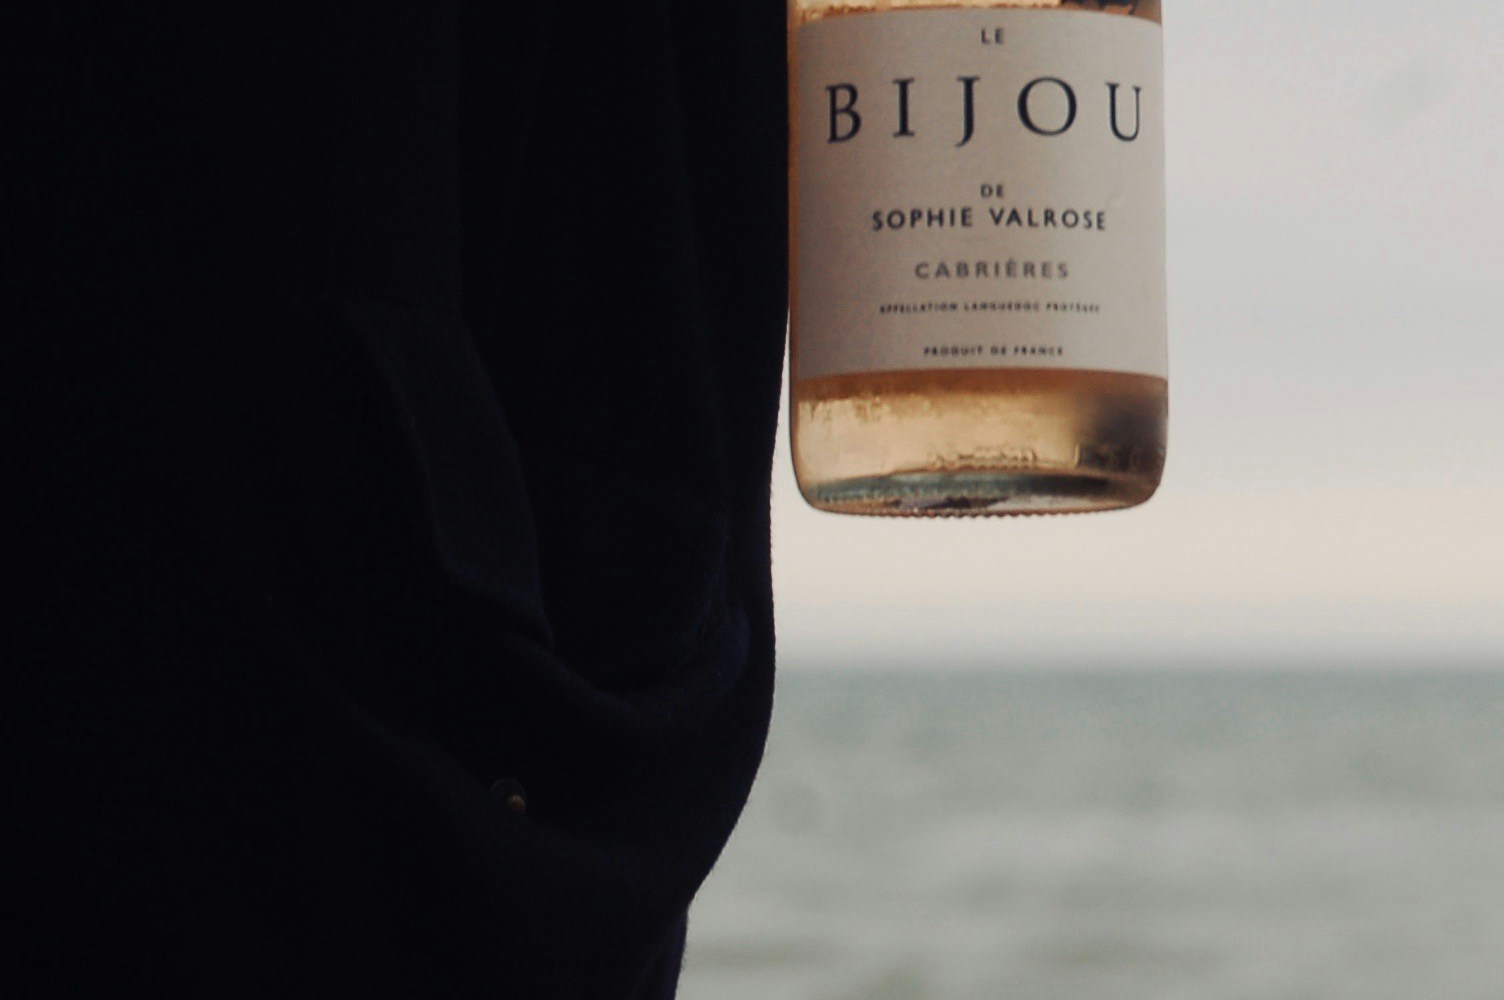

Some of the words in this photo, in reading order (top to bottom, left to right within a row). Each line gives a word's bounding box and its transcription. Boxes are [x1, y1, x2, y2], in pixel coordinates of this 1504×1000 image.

[980, 27, 1005, 46] LE
[824, 74, 1143, 149] BIJOU
[979, 182, 1006, 200] DE
[870, 205, 974, 233] SOPHIE
[987, 205, 1107, 232] VALROSE
[913, 257, 1070, 281] CABRIÈRES
[922, 344, 985, 357] PRODUIT
[989, 344, 1008, 357] DE
[1012, 345, 1064, 357] FRANCE
